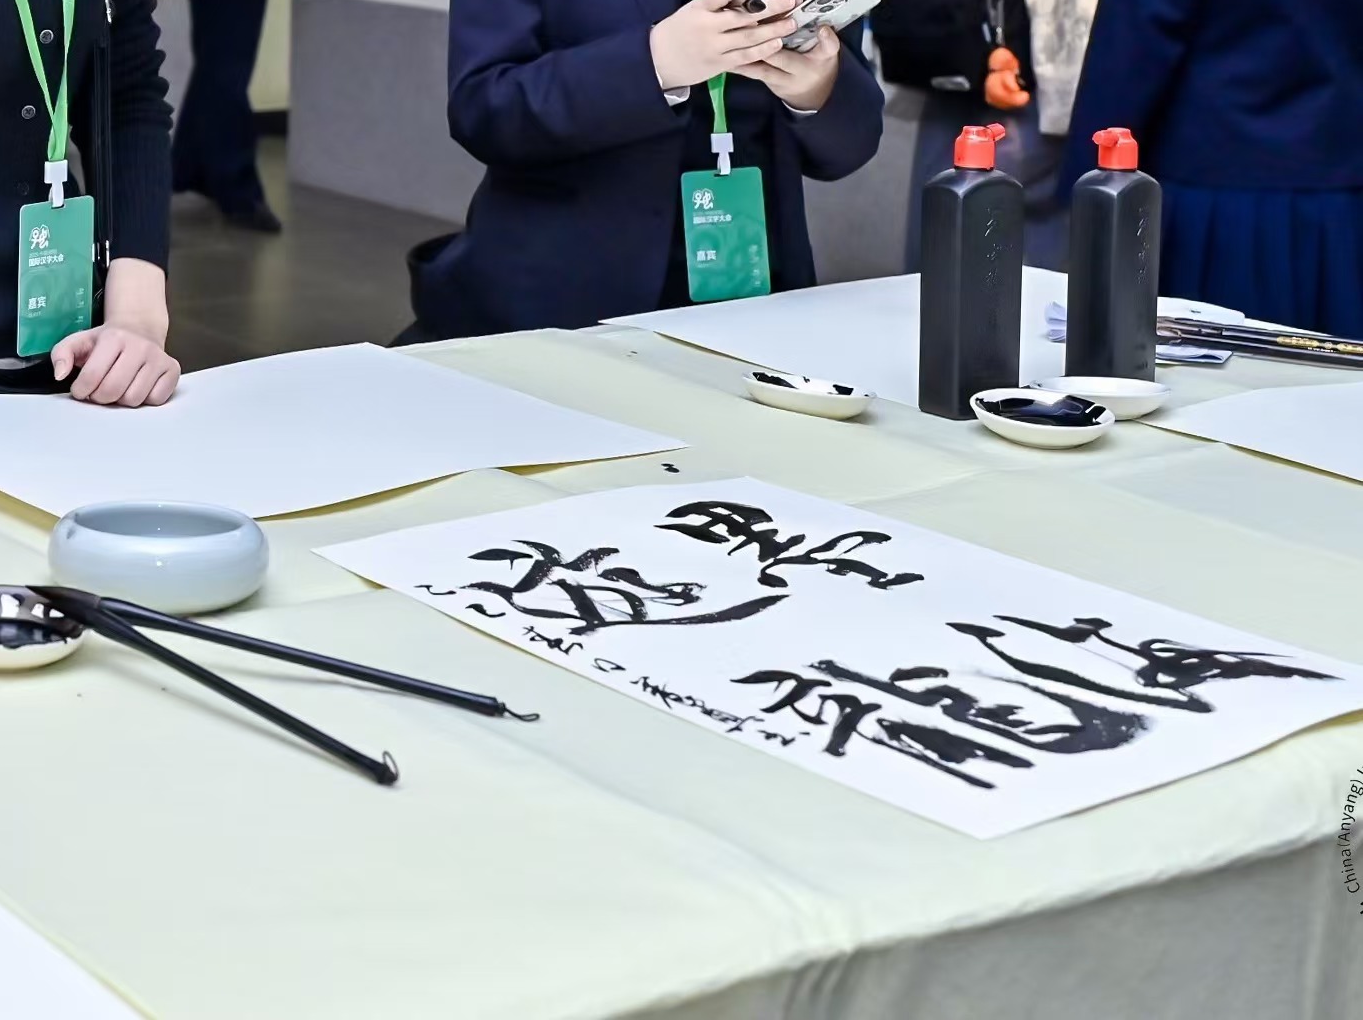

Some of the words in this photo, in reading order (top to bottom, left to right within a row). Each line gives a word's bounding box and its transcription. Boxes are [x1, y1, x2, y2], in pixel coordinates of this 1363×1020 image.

[28, 254, 64, 267] 国际汉字大会
[28, 296, 46, 310] 嘉宾
